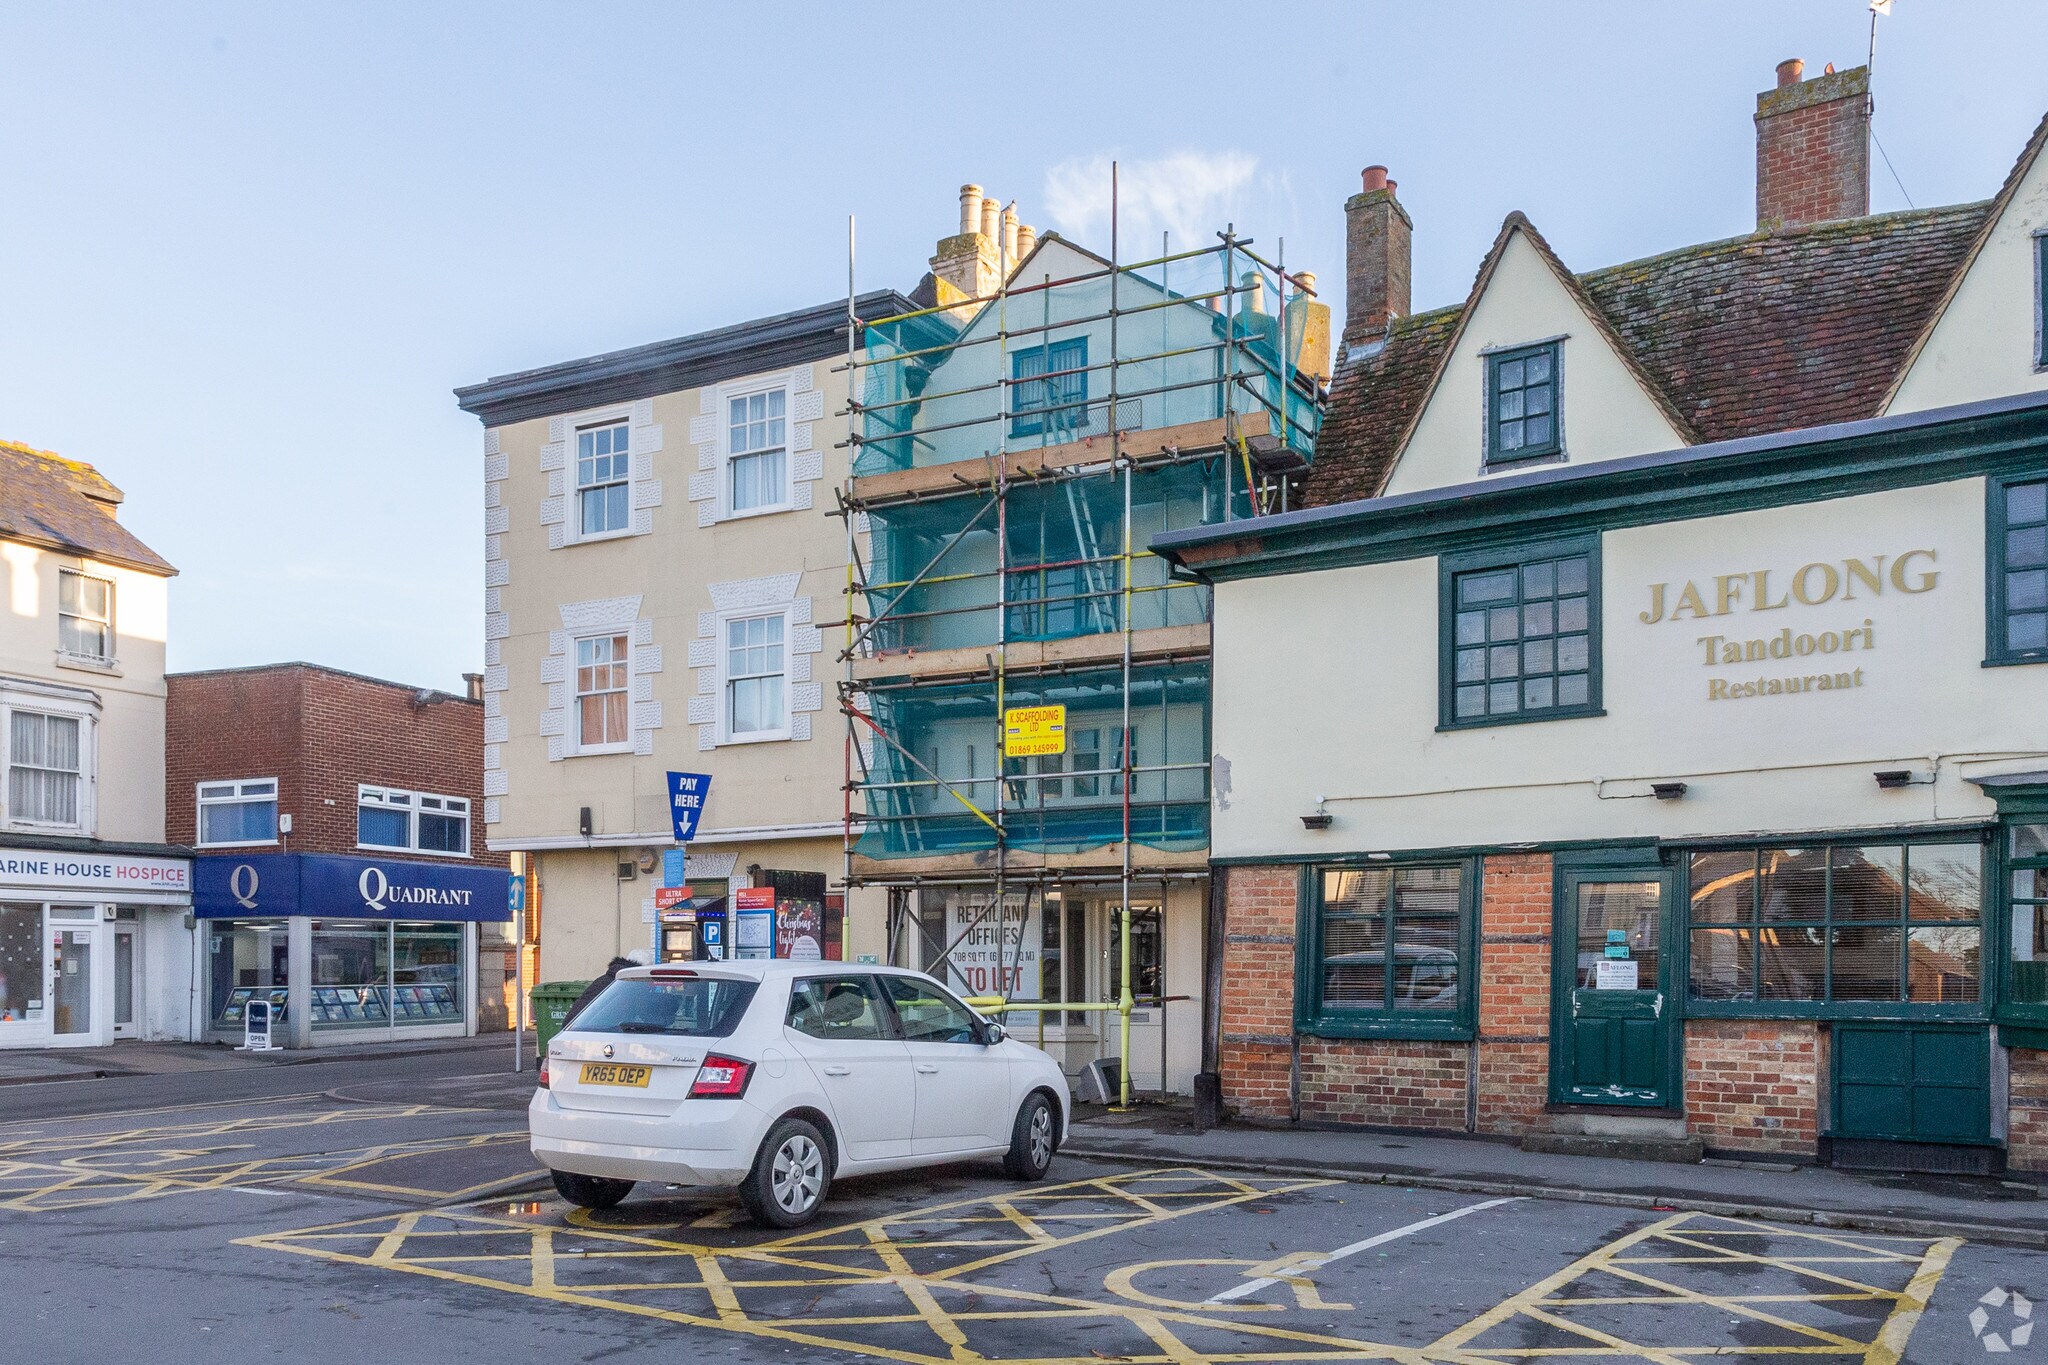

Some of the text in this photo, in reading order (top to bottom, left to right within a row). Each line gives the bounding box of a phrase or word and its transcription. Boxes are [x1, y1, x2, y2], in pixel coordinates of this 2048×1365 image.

[1639, 548, 1941, 625] JAFLONG
[1697, 618, 1875, 666] Tandoori
[1708, 666, 1864, 700] Restaurant
[1030, 721, 1039, 732] LTD
[1010, 743, 1059, 755] 01869 345999
[680, 777, 697, 791] PAY
[675, 794, 700, 808] HERE
[54, 862, 112, 878] HOUSE
[116, 866, 185, 881] HOSPICE
[230, 864, 259, 909] Q
[358, 867, 473, 911] QUADRANT
[777, 912, 812, 931] Christmas
[957, 904, 999, 923] RETAIL
[708, 925, 718, 941] P
[953, 951, 967, 962] 708
[964, 966, 1024, 992] TO LET
[585, 1066, 616, 1082] YR65
